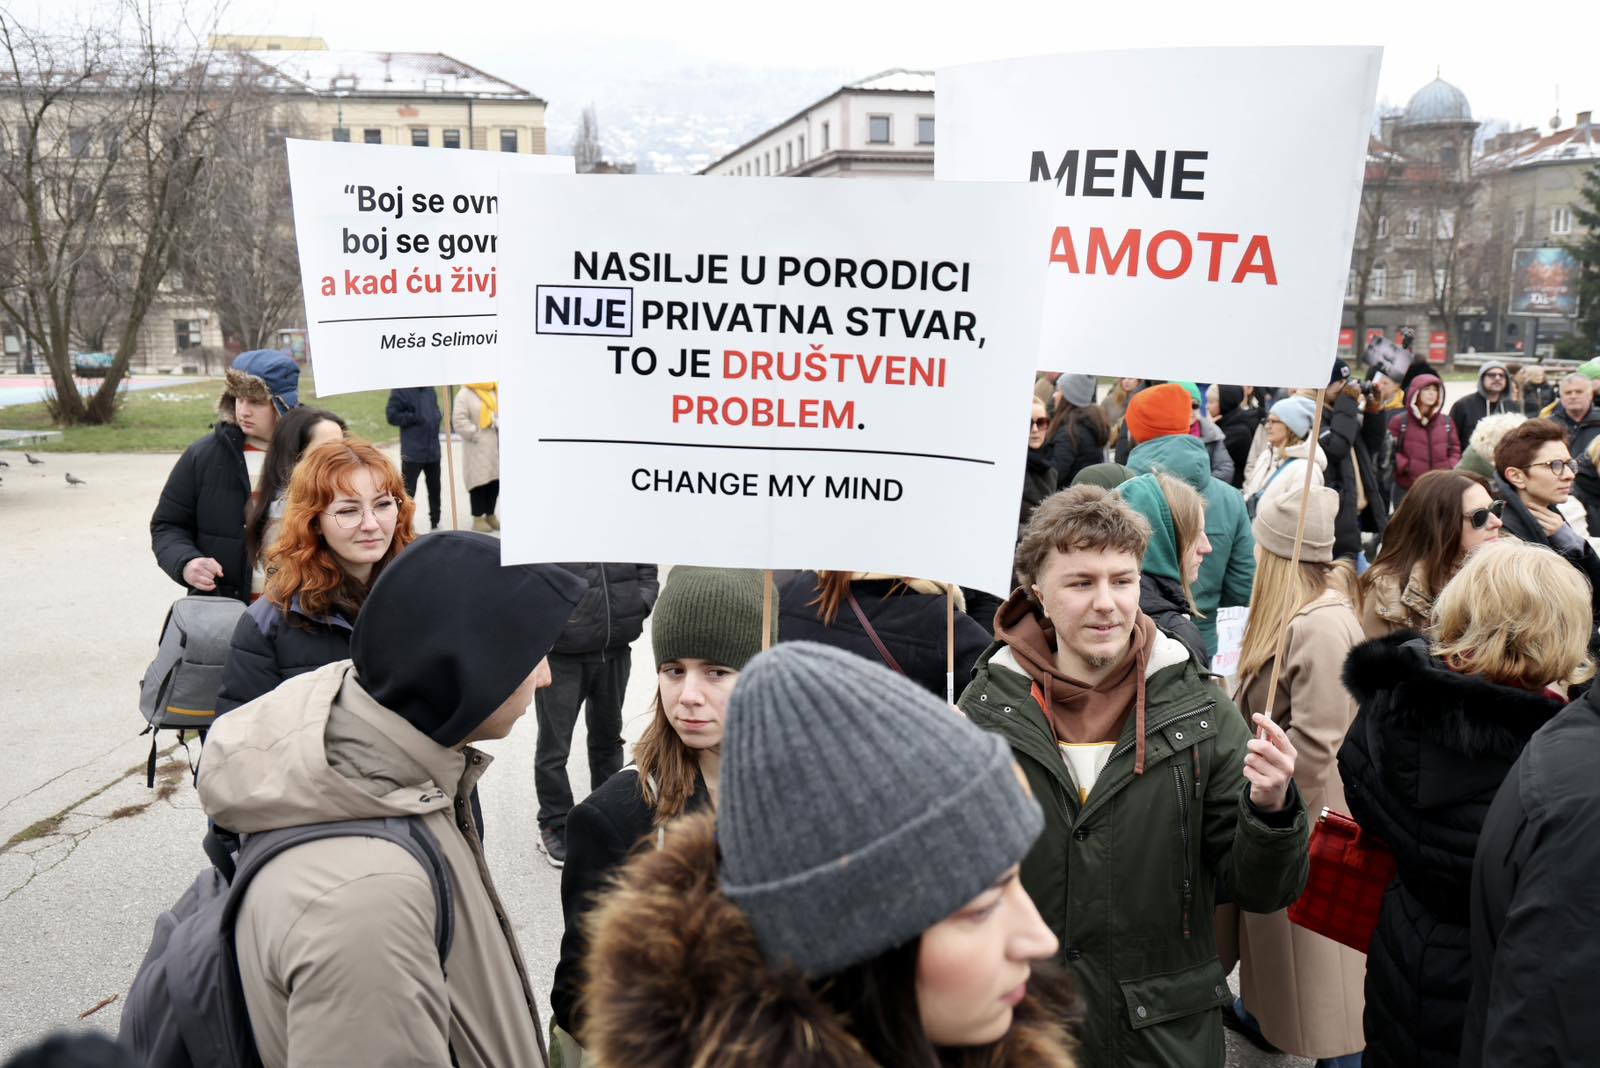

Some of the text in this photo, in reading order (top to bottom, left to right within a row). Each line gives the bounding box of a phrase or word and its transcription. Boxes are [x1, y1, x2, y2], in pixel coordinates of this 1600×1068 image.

[1030, 149, 1209, 201] MENE
[412, 192, 445, 214] se
[342, 227, 388, 260] boj
[396, 233, 430, 254] se
[321, 266, 497, 299] a kad ću živj
[573, 251, 971, 293] NASILJE U PORODICI
[380, 329, 498, 349] Meša Selimovi
[544, 295, 986, 349] NIJE PRIVATNA STVAR,
[606, 344, 947, 388] TO JE DRUŠTVENI
[672, 394, 866, 431] PROBLEM.
[631, 467, 904, 502] CHANGE MY MIND
